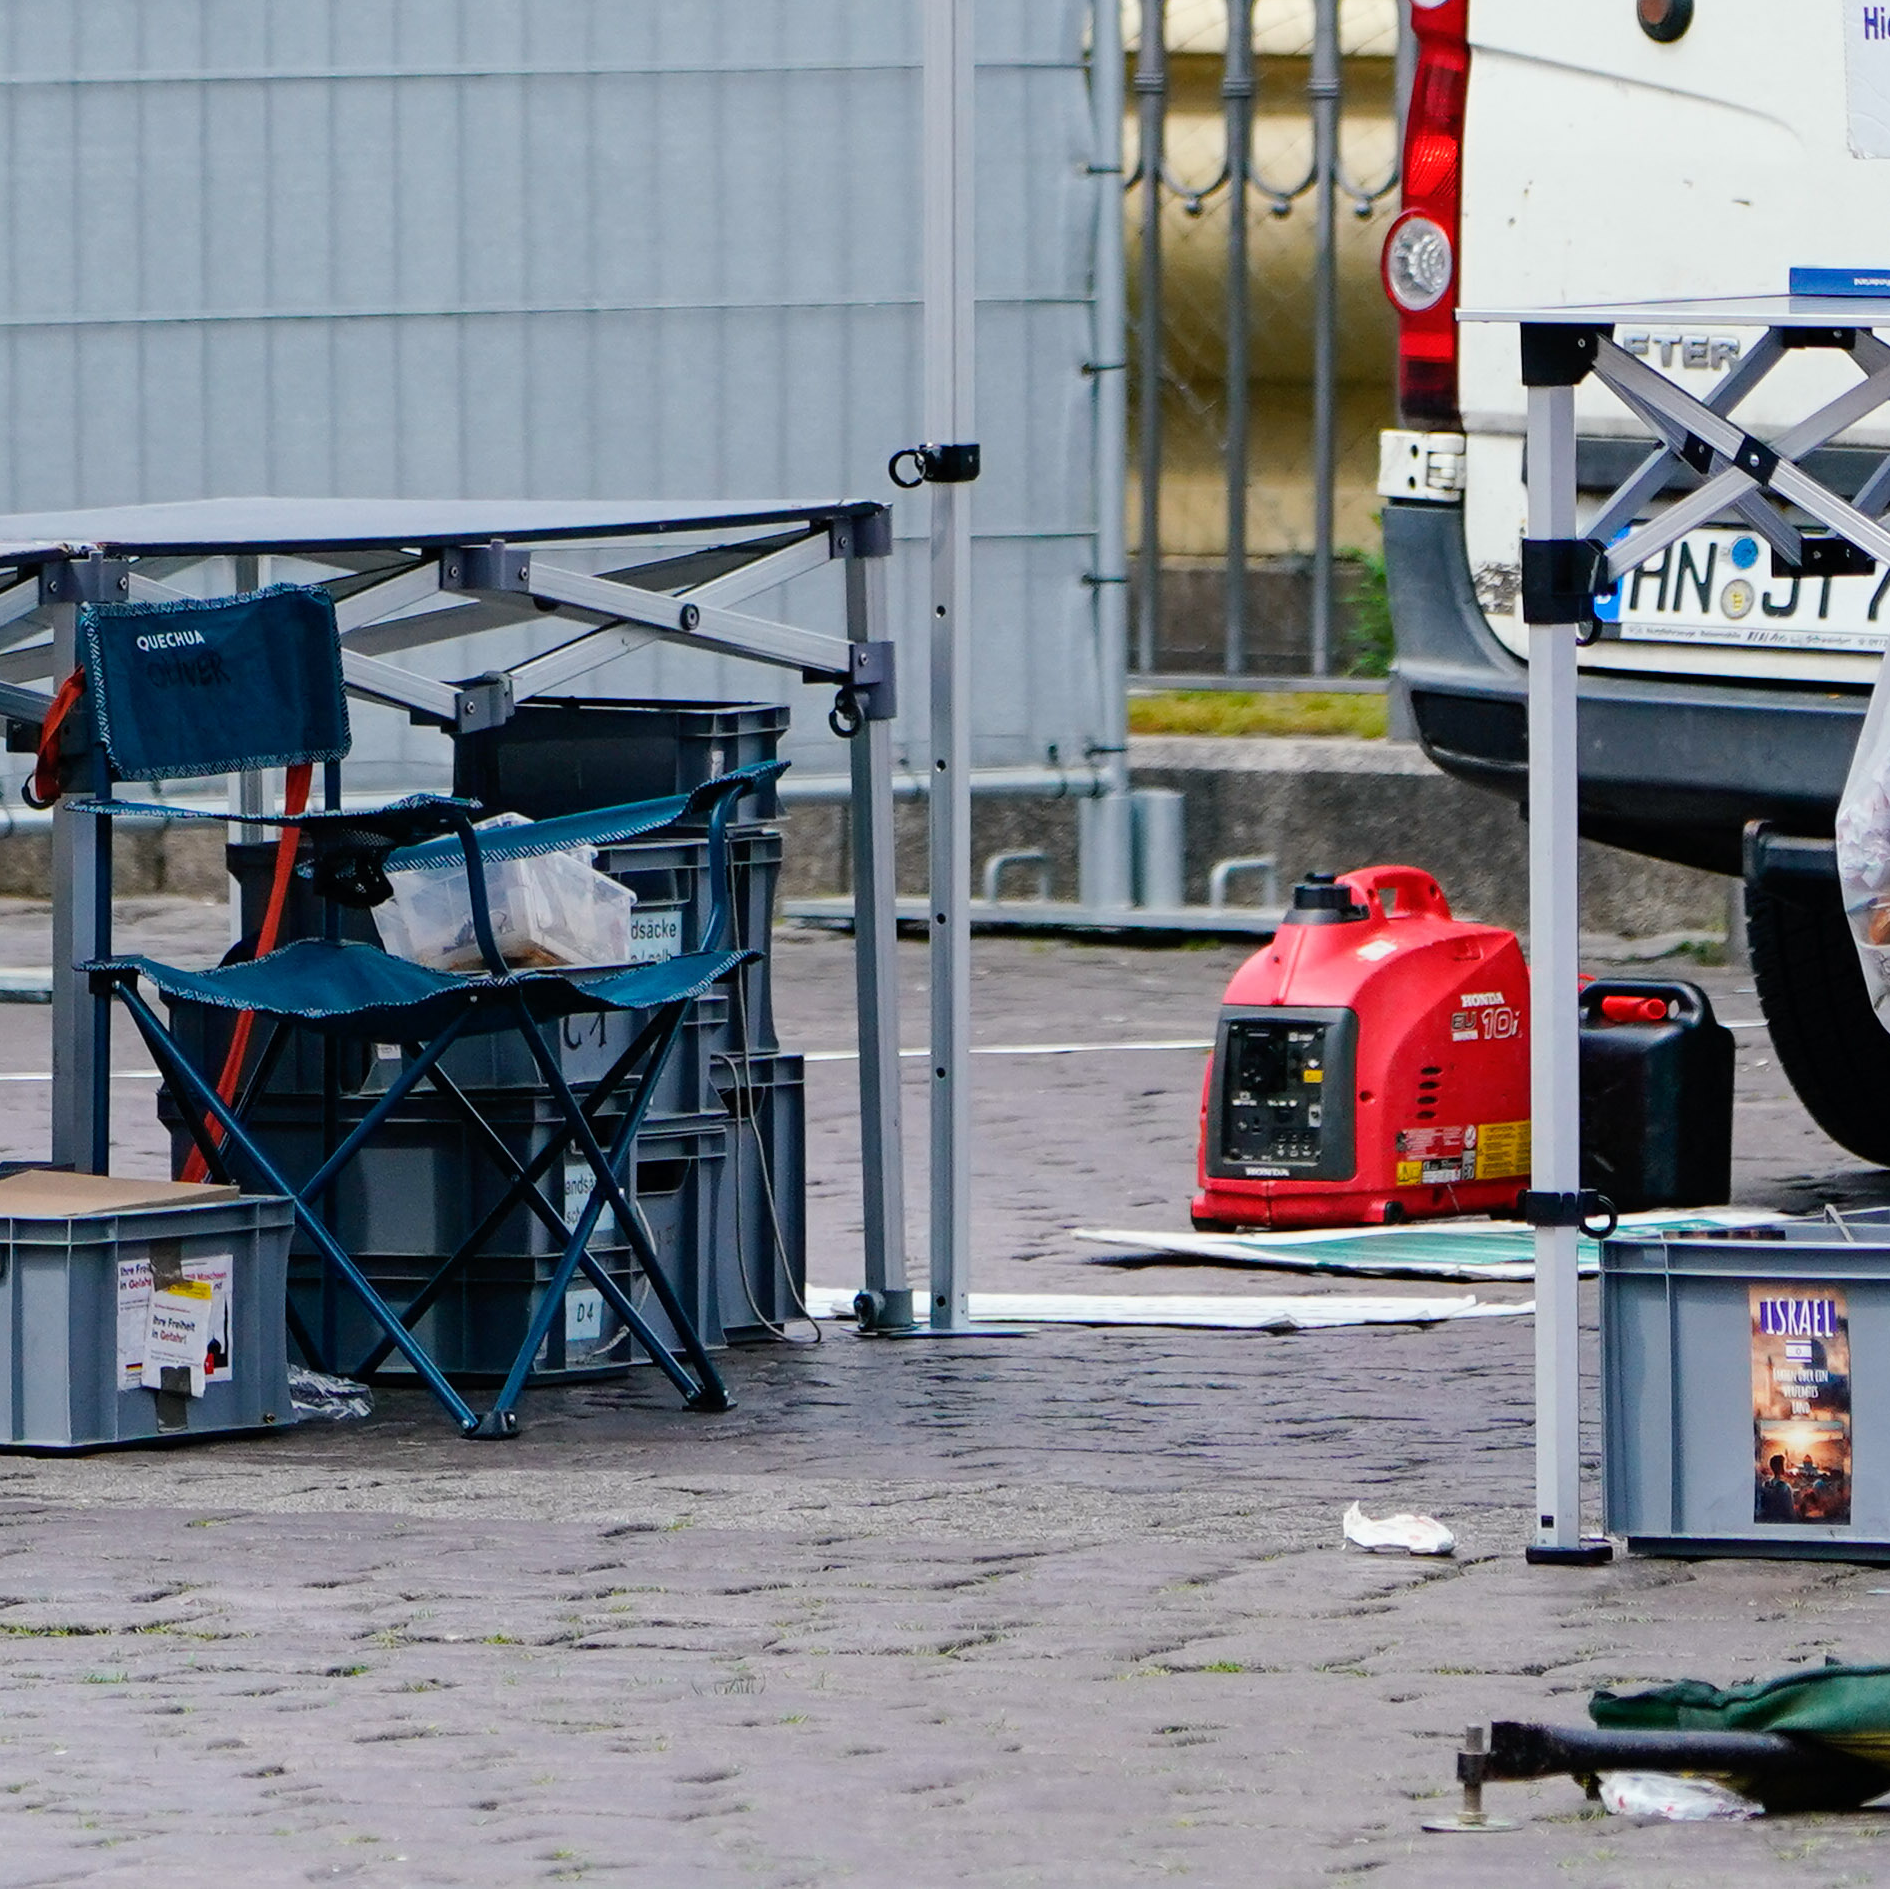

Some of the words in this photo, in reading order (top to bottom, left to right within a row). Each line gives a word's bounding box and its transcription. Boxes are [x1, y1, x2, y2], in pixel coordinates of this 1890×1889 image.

[1629, 540, 1718, 614] HN
[136, 629, 206, 652] QUECHUA
[1461, 992, 1505, 1007] HONDA
[1245, 1167, 1290, 1177] HONDA
[1766, 1297, 1834, 1338] ISRAEL
